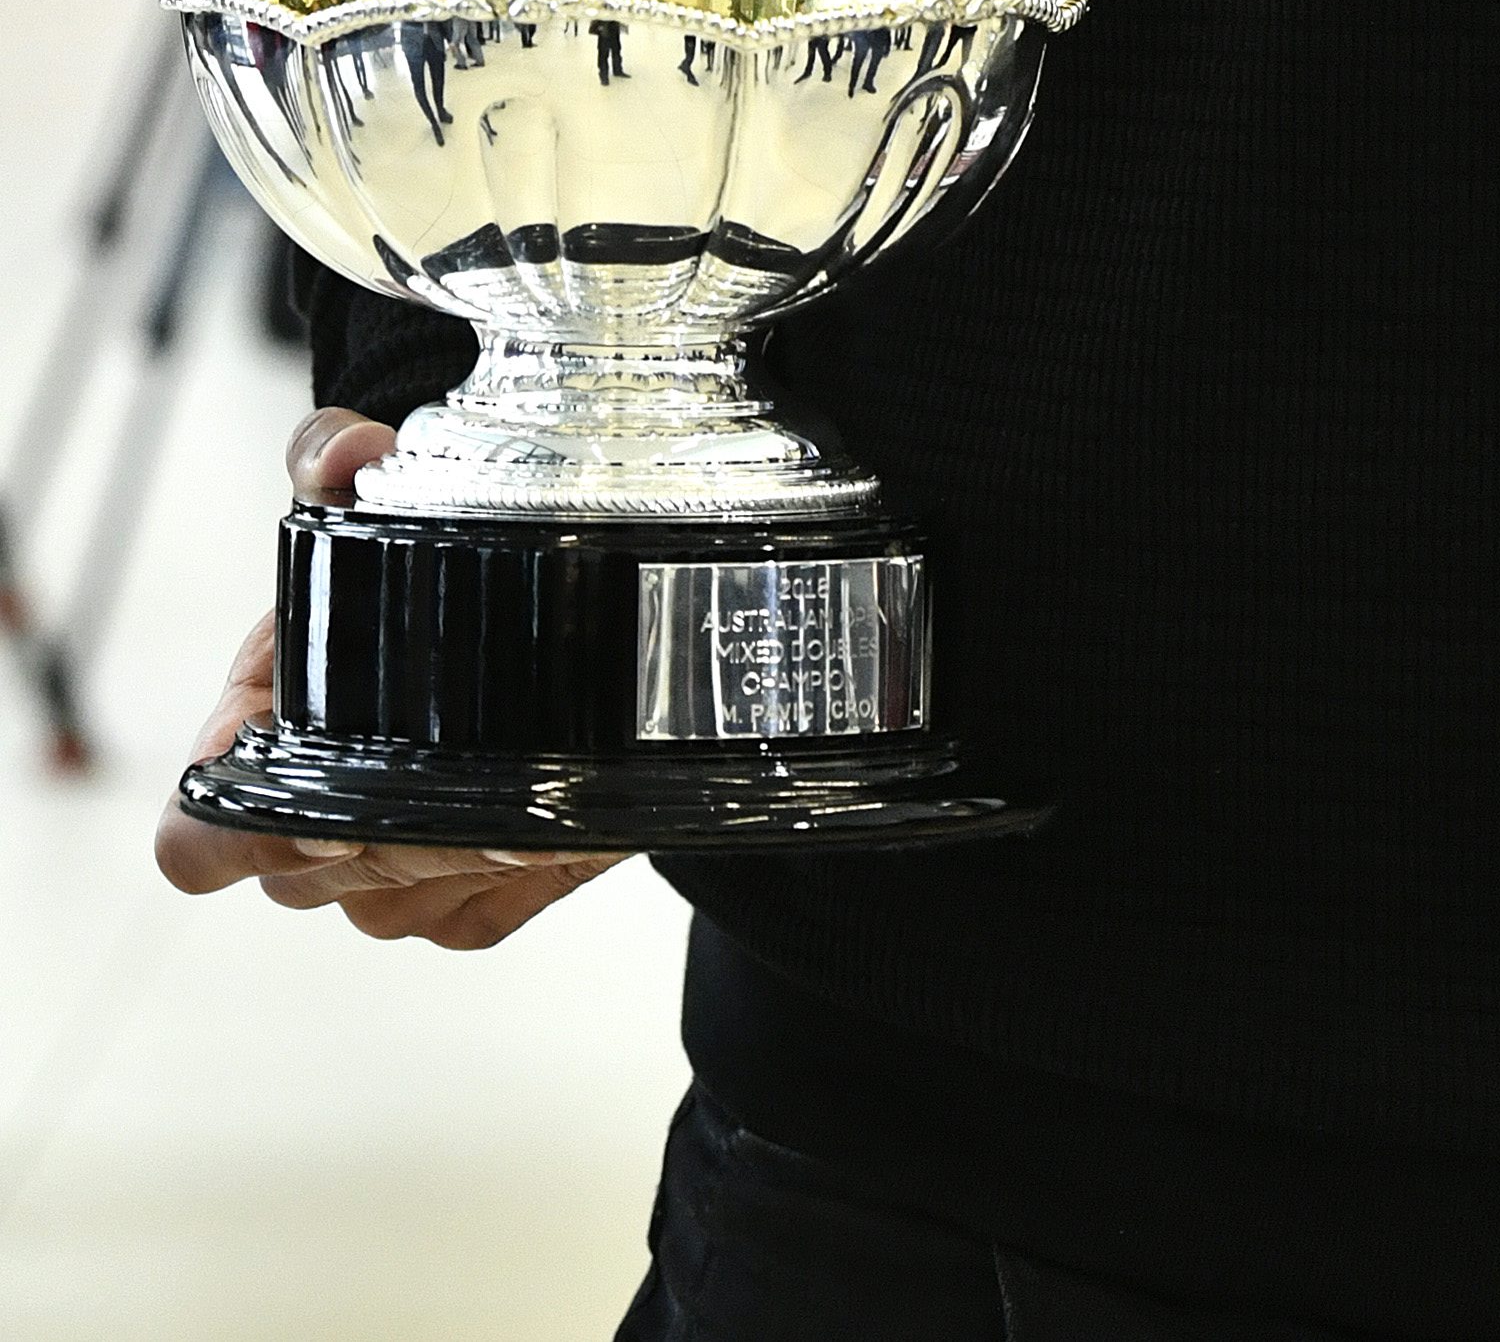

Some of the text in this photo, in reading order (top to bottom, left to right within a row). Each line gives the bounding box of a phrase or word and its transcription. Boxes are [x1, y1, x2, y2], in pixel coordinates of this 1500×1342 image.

[779, 577, 829, 599] 2018
[700, 606, 833, 632] AUSTRALIAN
[716, 637, 878, 664] MIXED DOUBLES
[741, 669, 857, 696] CHAMPION
[751, 700, 814, 724] PAVIC
